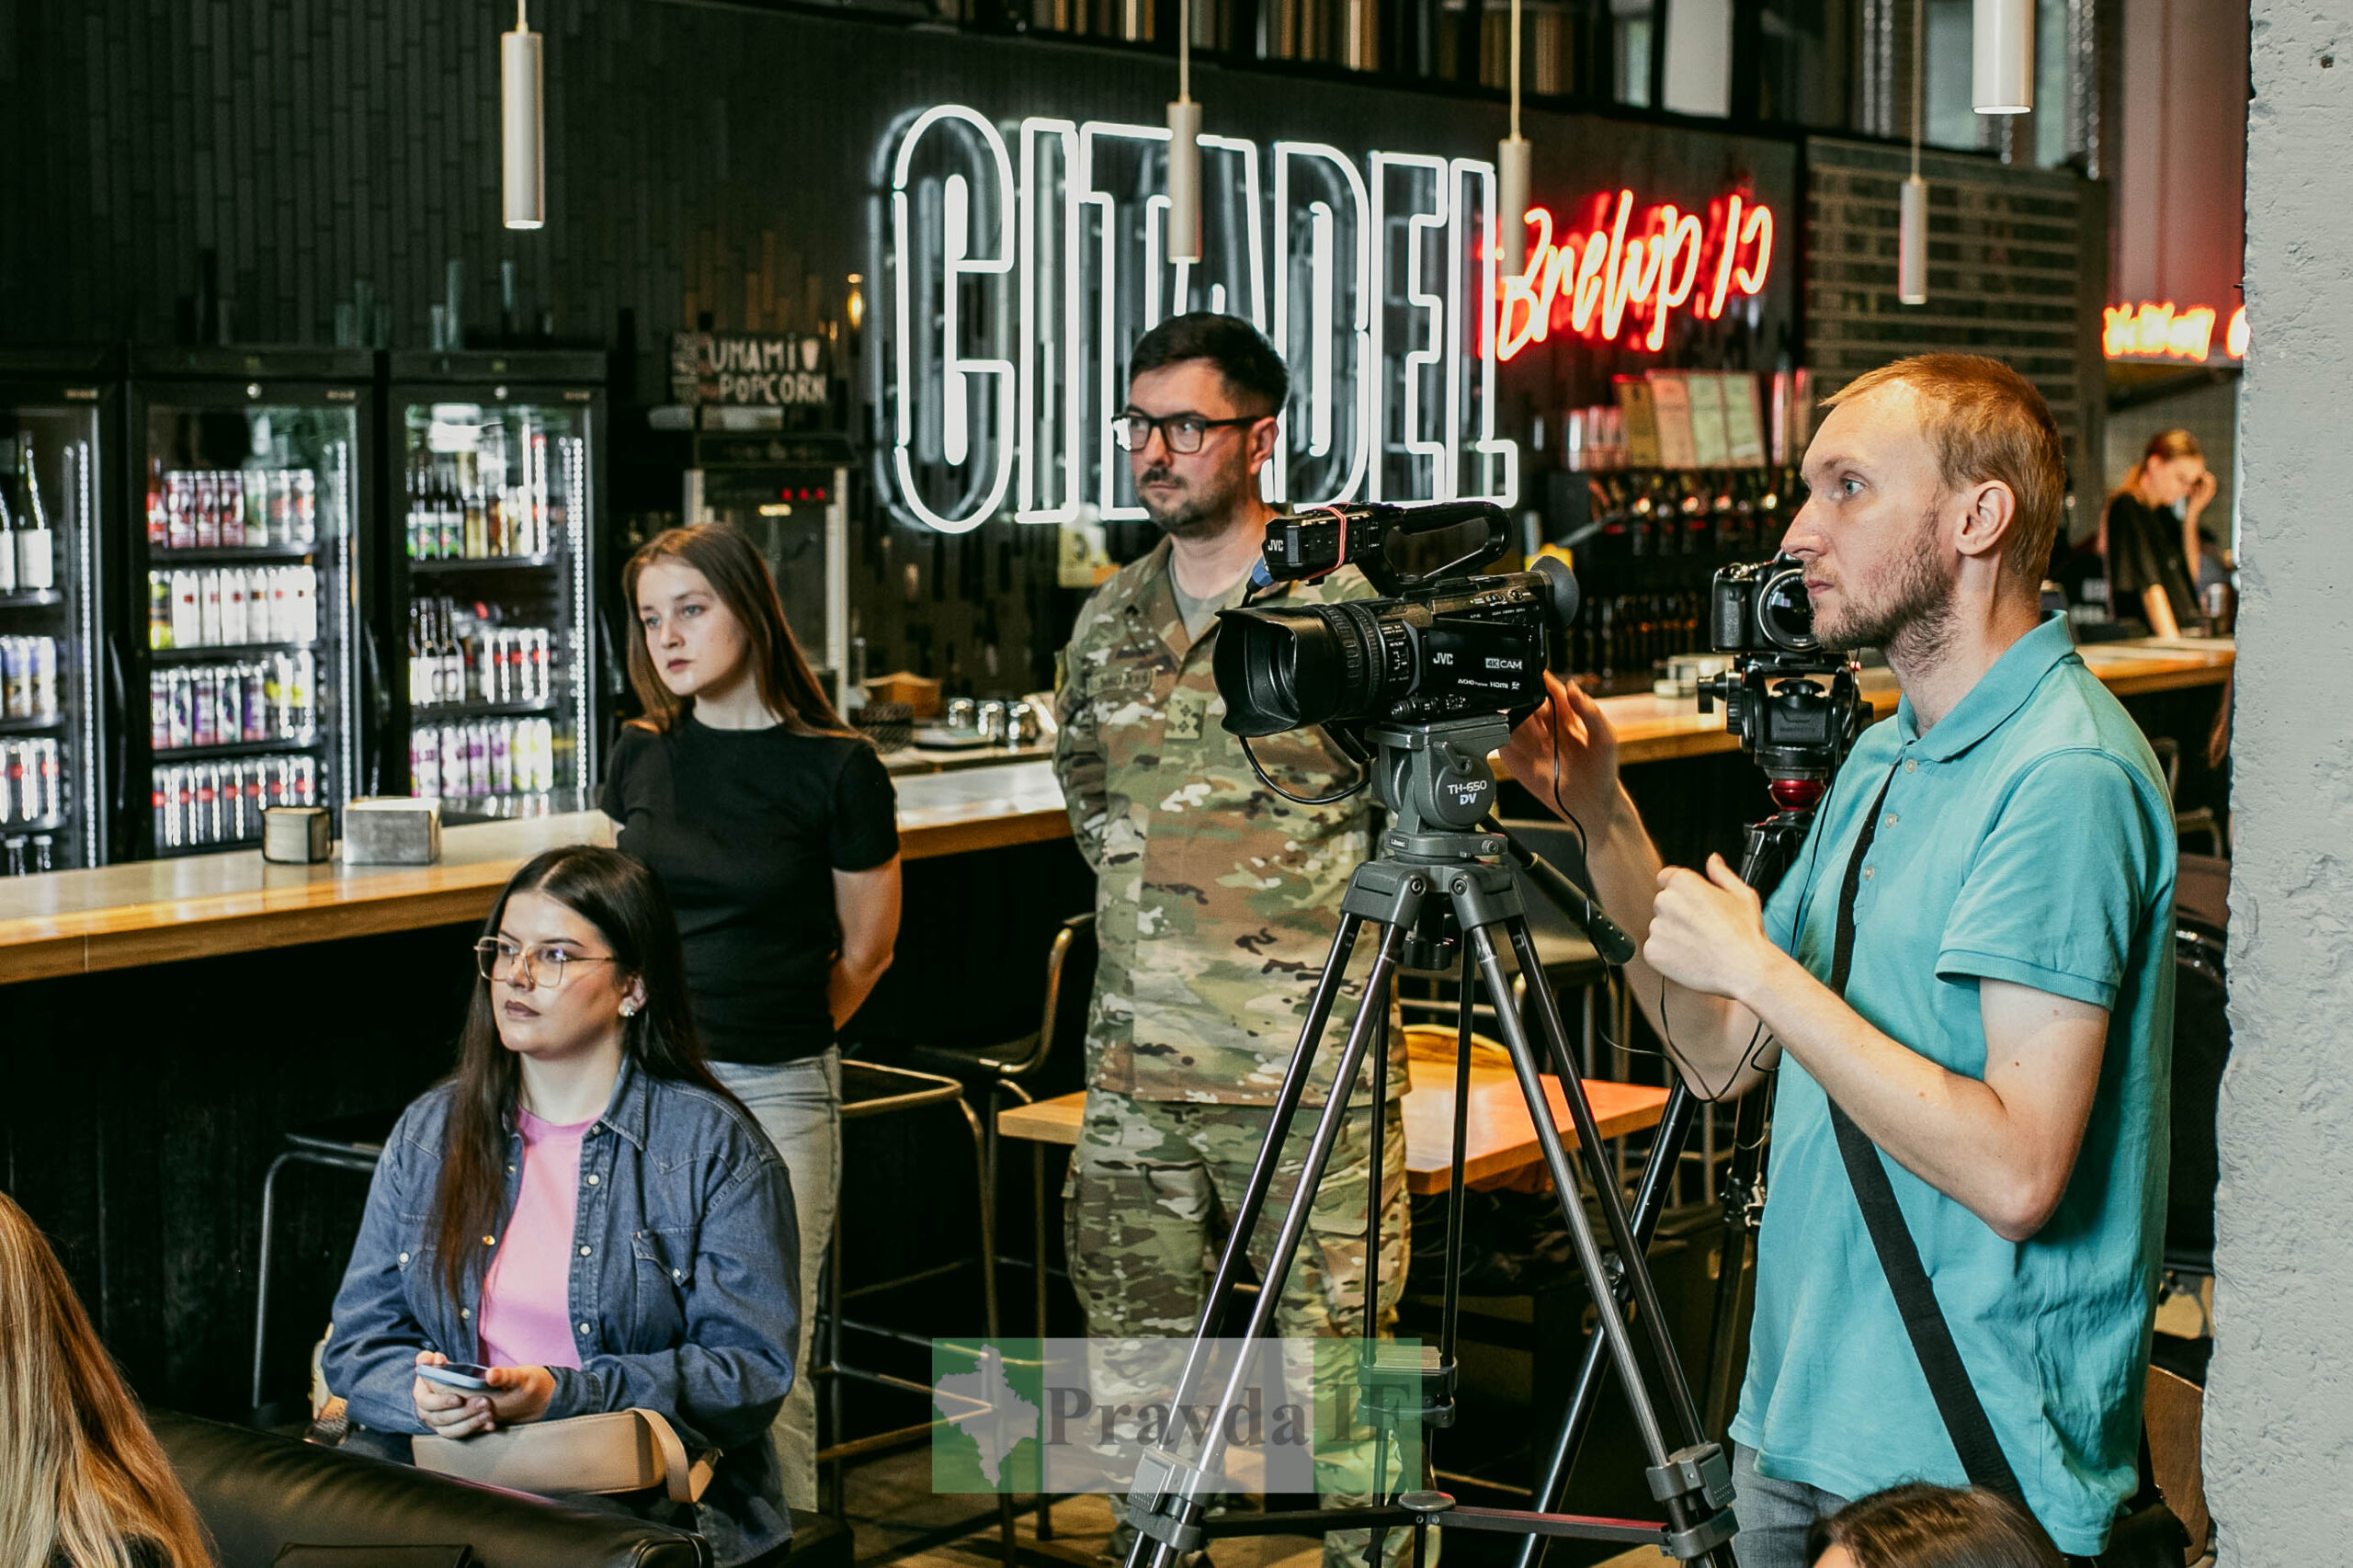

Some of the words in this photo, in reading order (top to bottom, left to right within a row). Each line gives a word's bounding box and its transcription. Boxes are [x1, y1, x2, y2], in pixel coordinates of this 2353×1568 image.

[1267, 540, 1284, 551] JVC
[1432, 652, 1454, 665] JVC
[1447, 779, 1487, 794] TH-650
[1460, 792, 1477, 806] DV
